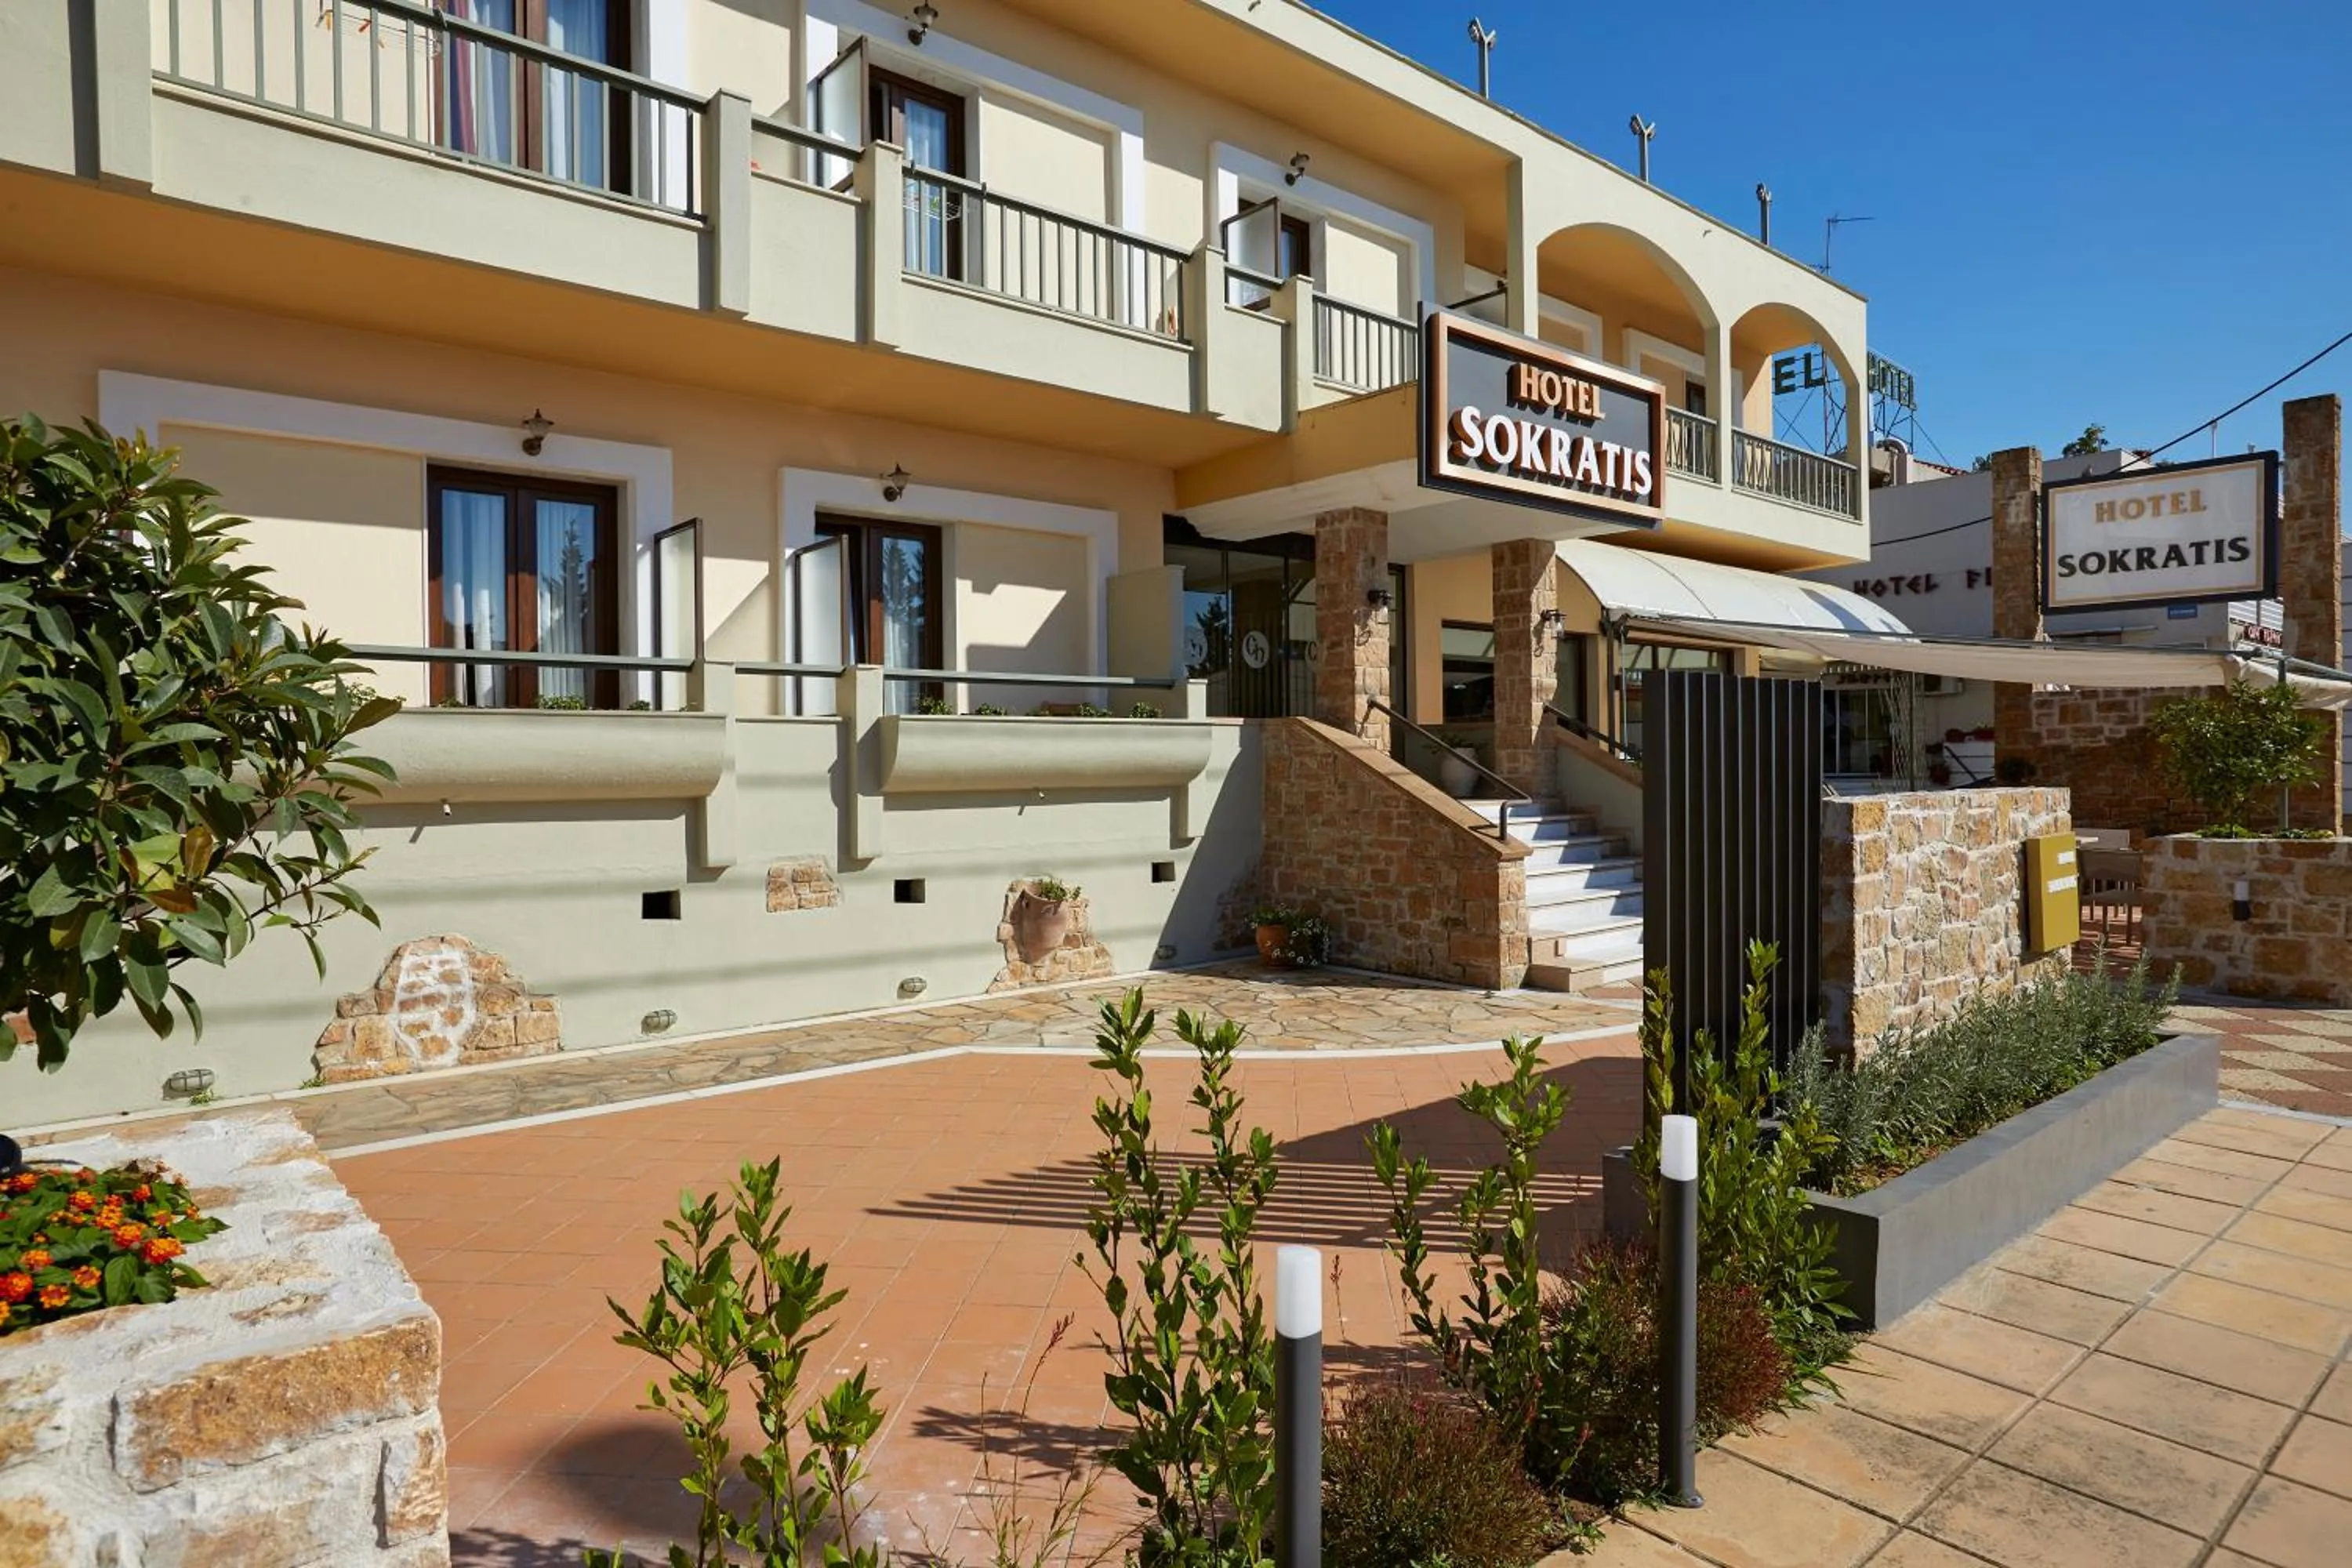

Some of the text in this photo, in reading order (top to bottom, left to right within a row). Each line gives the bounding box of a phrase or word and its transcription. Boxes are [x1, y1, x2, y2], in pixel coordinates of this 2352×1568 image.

[1515, 362, 1606, 421] HOTEL
[1458, 405, 1652, 495] SOKRATIS
[2095, 489, 2208, 524] HOTEL
[2057, 536, 2251, 578] SOKRATIS
[1853, 573, 1939, 597] HOTEL
